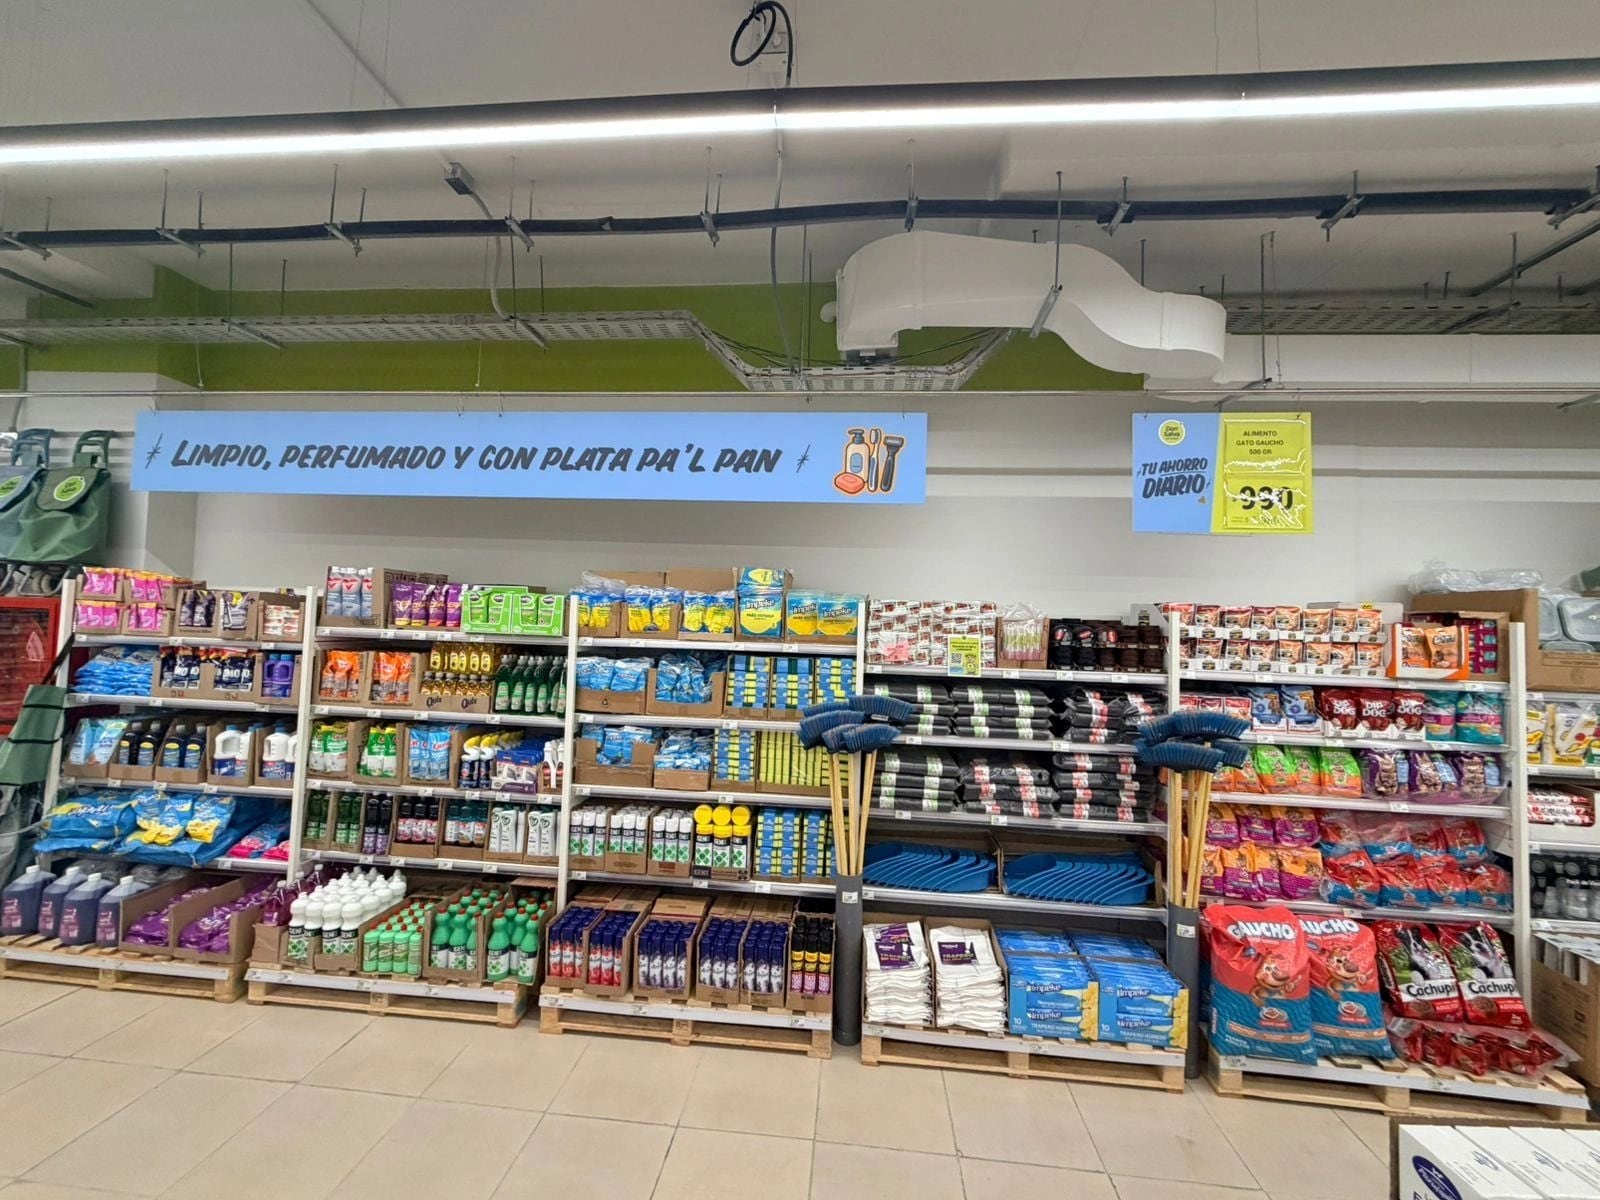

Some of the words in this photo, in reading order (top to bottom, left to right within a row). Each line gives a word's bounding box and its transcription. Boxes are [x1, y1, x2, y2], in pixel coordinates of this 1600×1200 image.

[171, 440, 271, 470] LIMPIO,
[279, 444, 446, 470] PERFUMADO
[454, 446, 474, 470] Y
[478, 444, 538, 470] CON
[539, 446, 633, 472] PLATA
[712, 448, 783, 474] PAN
[1142, 462, 1158, 476] TU
[1159, 457, 1209, 473] AHORRO
[1142, 474, 1206, 499] DIARIO
[1226, 920, 1296, 940] GAUCHO
[1299, 918, 1360, 935] AUCHO
[1030, 984, 1062, 993] Impeke
[1013, 1017, 1022, 1025] 10
[1030, 1012, 1062, 1020] Impeke
[1100, 1023, 1110, 1032] 10
